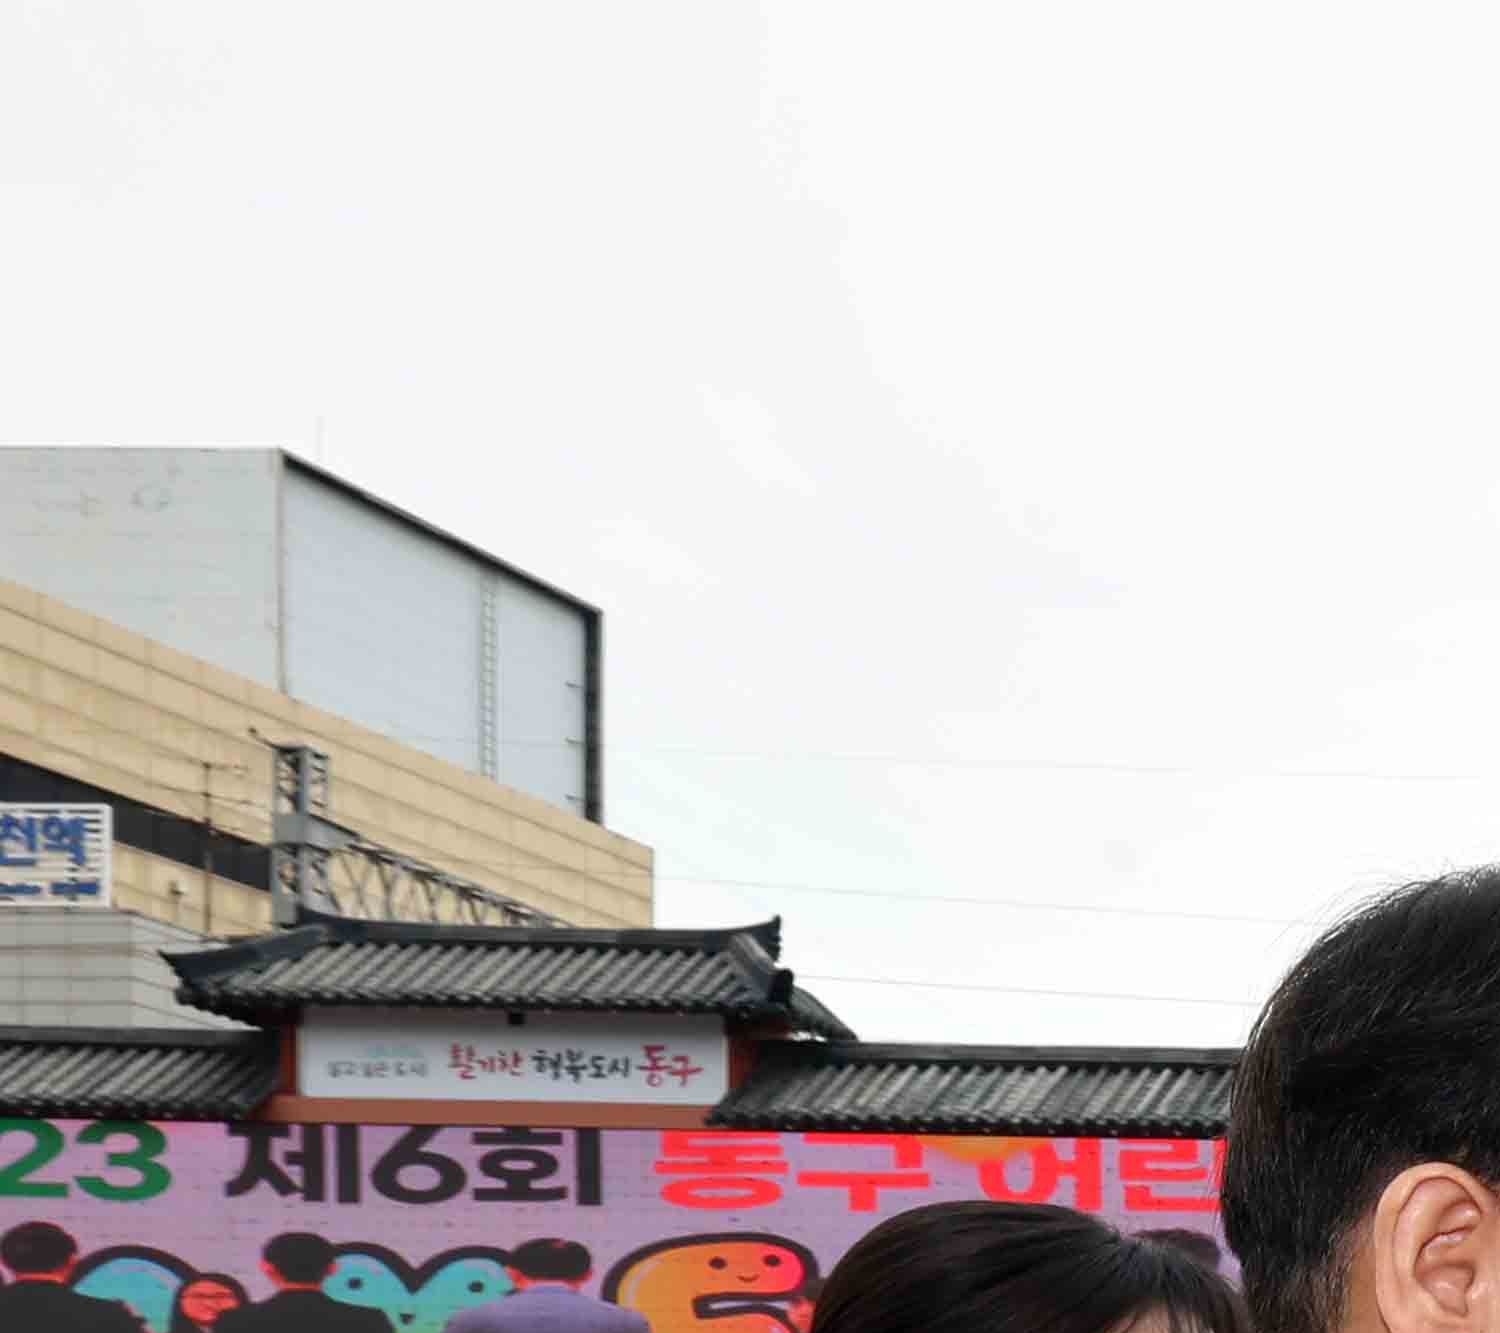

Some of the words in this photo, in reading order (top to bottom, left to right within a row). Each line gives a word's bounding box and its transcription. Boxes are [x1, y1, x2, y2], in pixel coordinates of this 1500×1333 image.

[636, 1044, 703, 1087] 동구
[225, 1122, 604, 1205] 제6회
[653, 1131, 930, 1212] 동구
